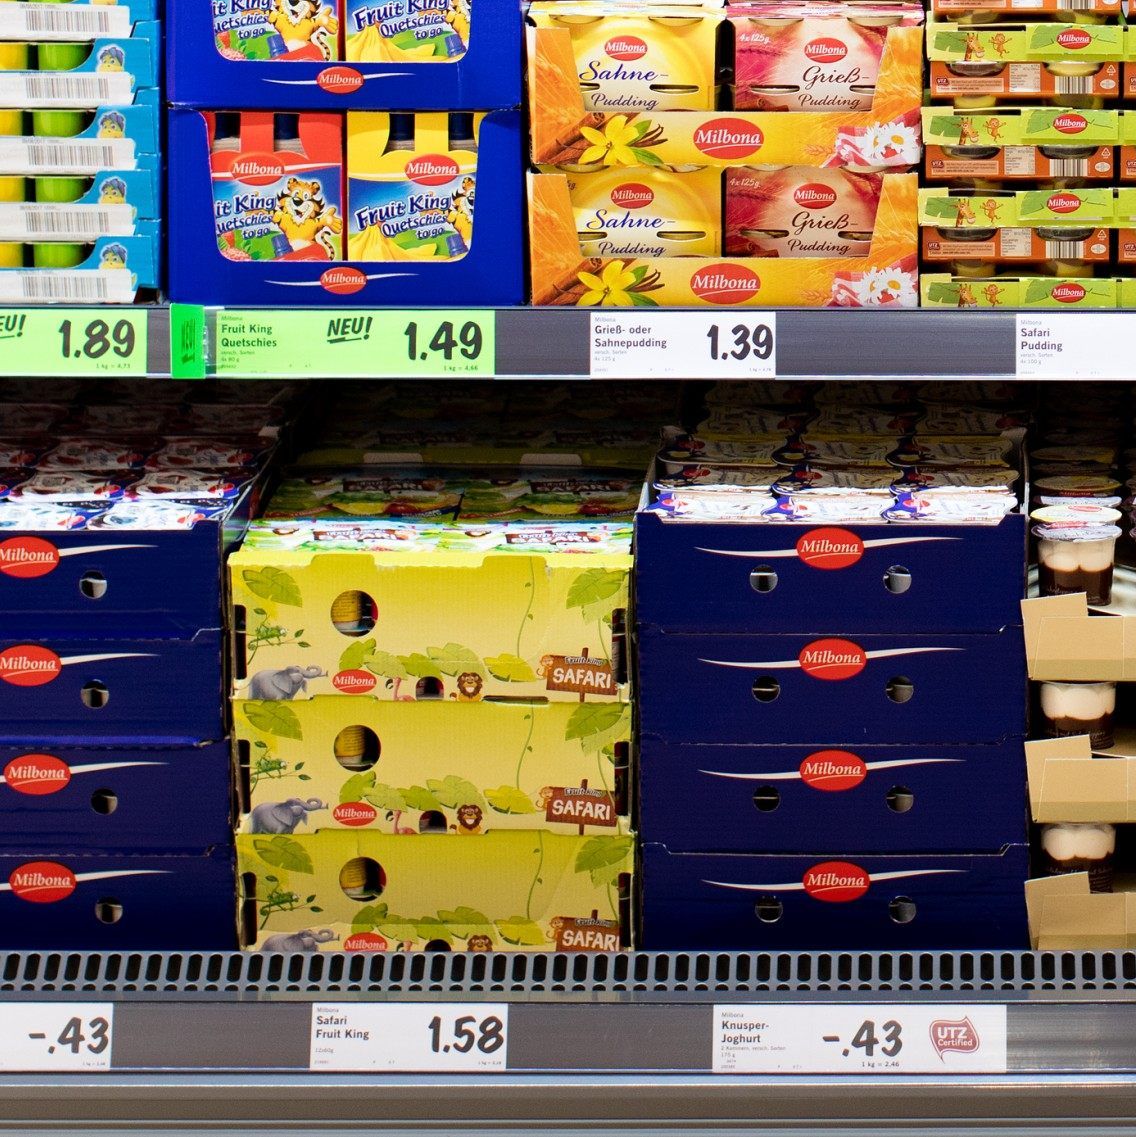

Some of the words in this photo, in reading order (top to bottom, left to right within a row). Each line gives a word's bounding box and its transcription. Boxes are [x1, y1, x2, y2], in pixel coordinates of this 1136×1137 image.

[354, 0, 403, 32] Fruit
[380, 12, 446, 38] Quetschies
[416, 29, 426, 40] to
[428, 26, 443, 40] go
[605, 42, 647, 54] Milbona
[591, 92, 659, 110] Pudding
[694, 128, 763, 147] Milbona
[407, 162, 457, 176] Milbona
[221, 324, 246, 334] Fruit
[250, 324, 272, 335] King
[327, 317, 373, 340] NEU!
[595, 325, 625, 334] Grieß-
[629, 326, 651, 334] oder
[1021, 328, 1050, 337] Safari
[58, 319, 135, 358] 1.89
[221, 338, 277, 347] Quetschies
[404, 320, 483, 361] 1.49
[595, 338, 667, 349] Sahnepudding
[707, 324, 773, 360] 1.39
[1021, 341, 1062, 352] Pudding
[801, 540, 860, 555] Milbona
[553, 668, 611, 688] SAFARI
[7, 765, 69, 781] Milbona
[806, 873, 865, 888] Milbona
[317, 1016, 347, 1025] Safari
[722, 1021, 769, 1032] Knusper-
[28, 1016, 110, 1055] -.43
[316, 1030, 340, 1038] Fruit
[345, 1029, 369, 1040] King
[428, 1015, 504, 1054] 1.58
[721, 1034, 761, 1045] Joghurt
[822, 1020, 903, 1057] -.43
[938, 1027, 967, 1040] UTZ
[938, 1039, 973, 1047] Certified
